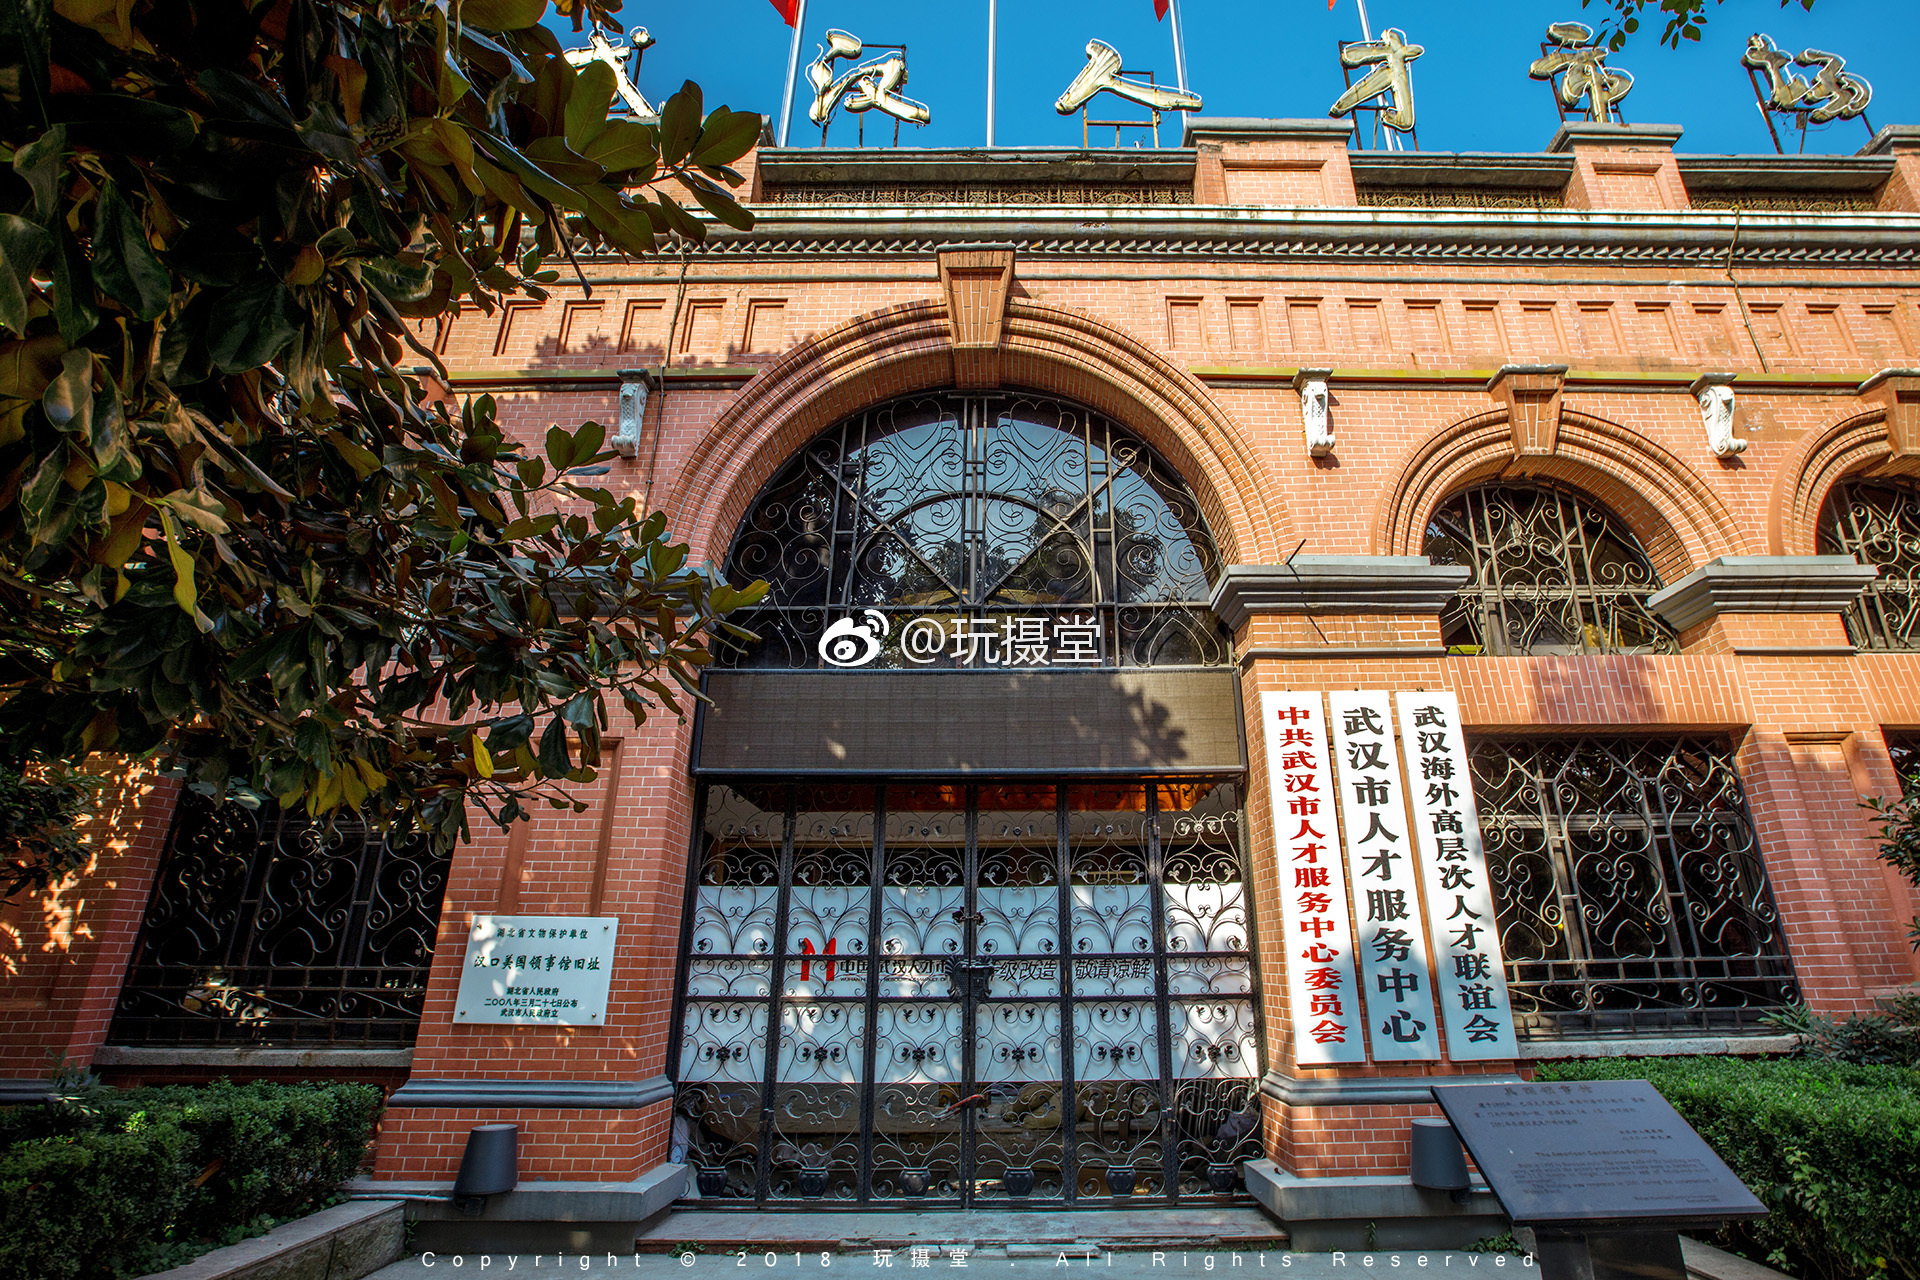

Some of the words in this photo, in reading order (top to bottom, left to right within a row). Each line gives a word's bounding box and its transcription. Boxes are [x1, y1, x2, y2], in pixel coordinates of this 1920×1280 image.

[1277, 706, 1349, 1045] 中共武汉市人才服务中心委员会
[1343, 706, 1427, 1044] 武汉市人才服务中心
[1412, 705, 1500, 1043] 武汉海外高层次人才联谊会
[496, 927, 589, 940] 湖北省文物保护单位
[474, 953, 601, 972] 汉口美国领事馆旧址
[1074, 959, 1152, 980] 敬请谅解
[506, 986, 560, 996] 湖北省人民政府
[500, 1008, 559, 1018] 武汉市人民政府立
